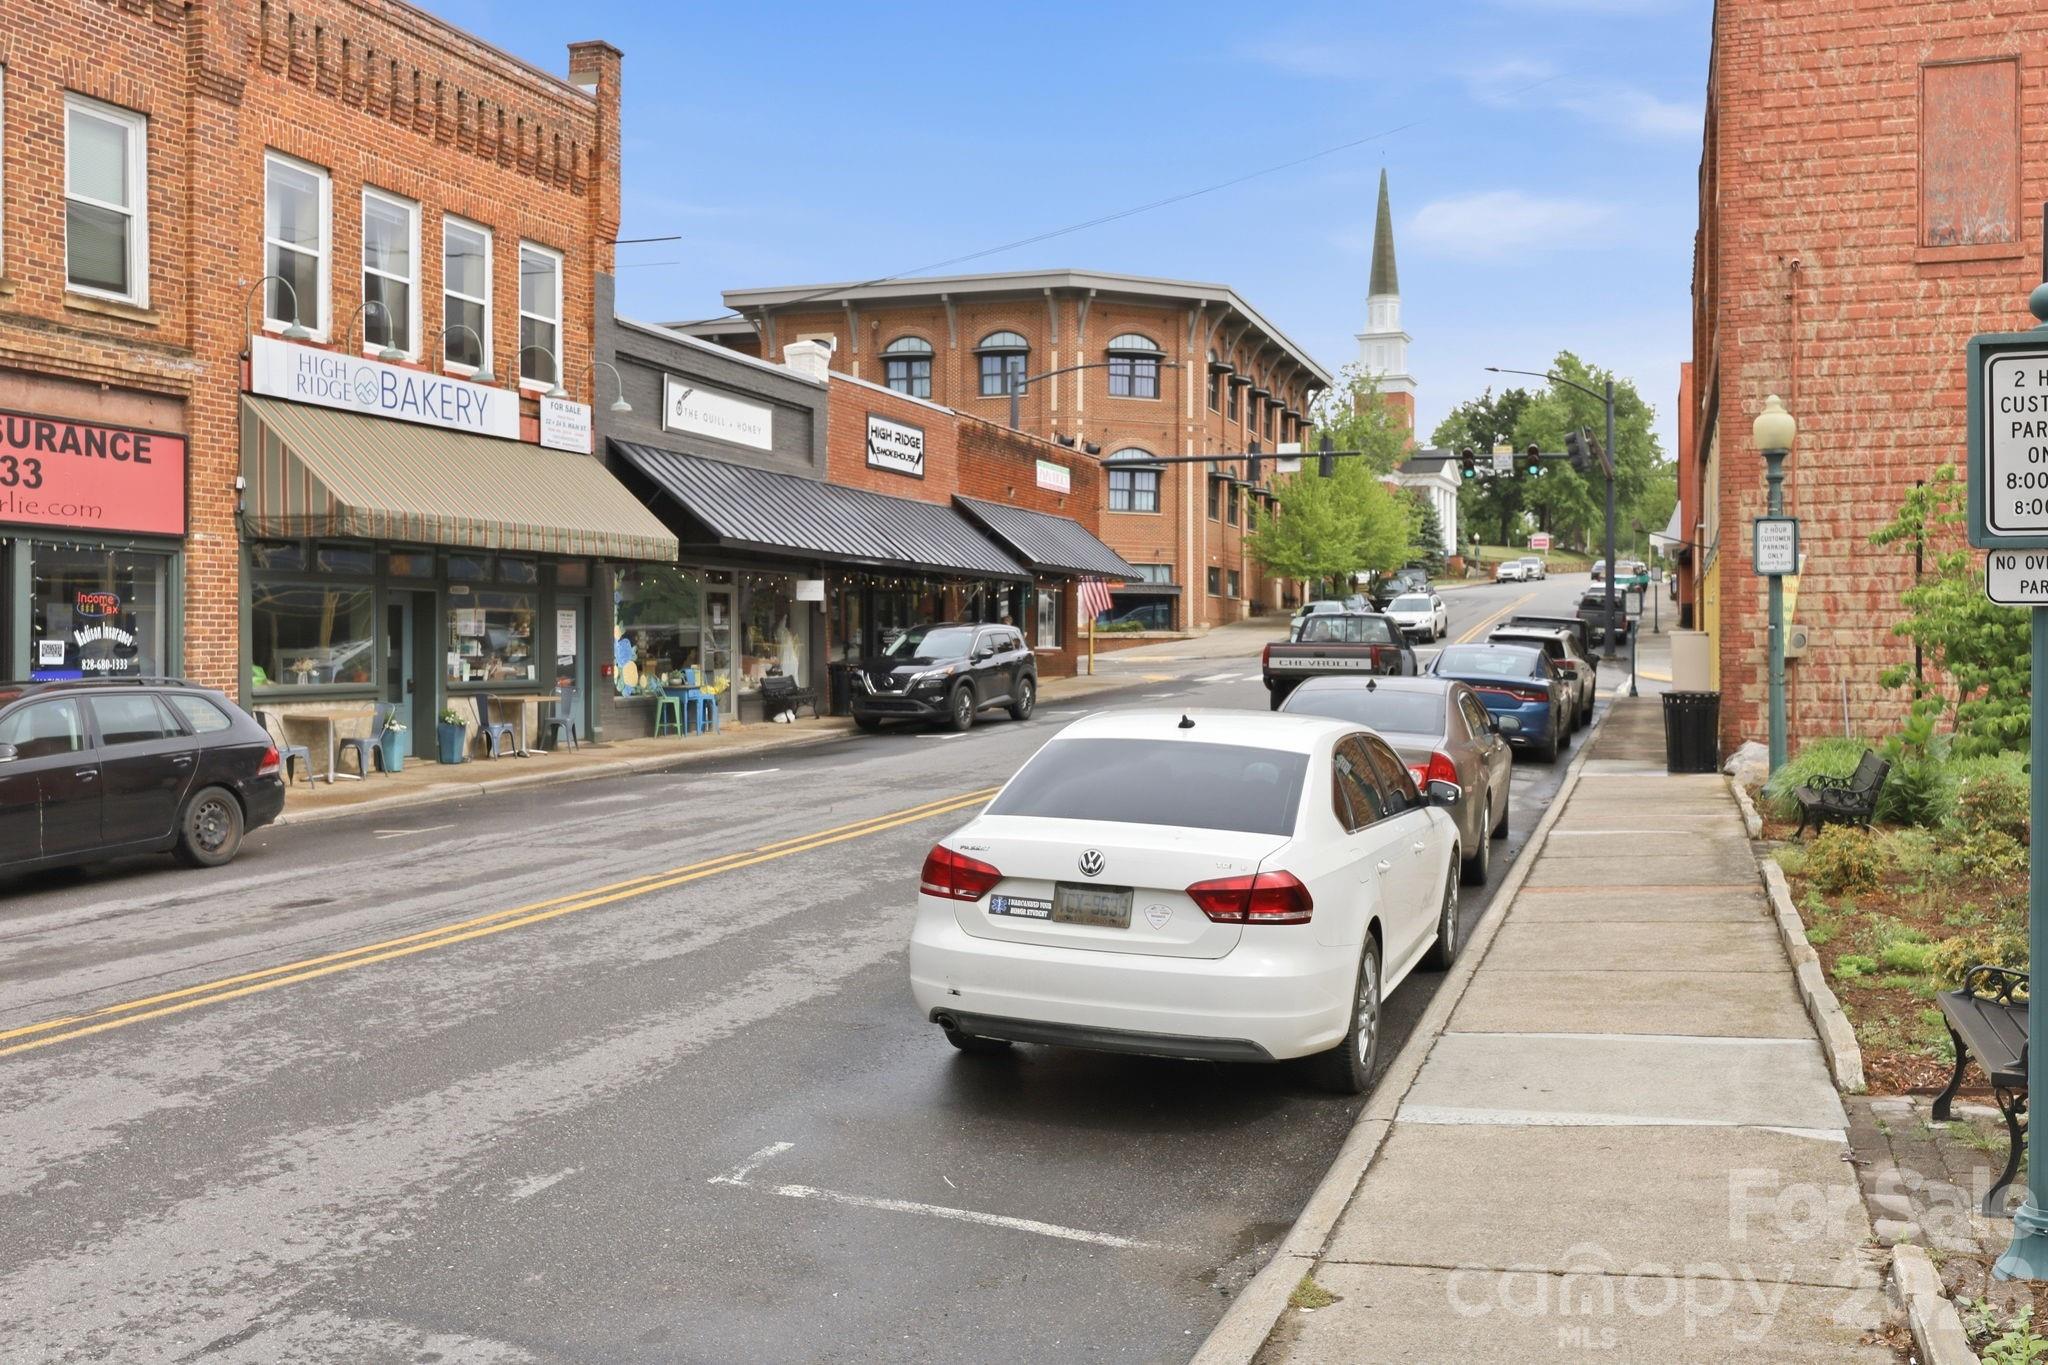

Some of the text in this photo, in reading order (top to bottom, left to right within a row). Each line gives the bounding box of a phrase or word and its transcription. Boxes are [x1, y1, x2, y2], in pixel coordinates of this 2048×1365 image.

[299, 353, 347, 380] HIGH
[2014, 370, 2025, 387] 2
[297, 373, 352, 402] RIDGE
[380, 370, 488, 427] BAKERY
[550, 401, 564, 412] FOR
[2001, 395, 2048, 413] CUST
[870, 425, 921, 449] HIGH RIDGE
[2012, 421, 2048, 438] PAR
[0, 415, 152, 464] URANCE
[2015, 498, 2048, 515] 8:0
[1767, 552, 1783, 560] ONLY
[1996, 555, 2048, 570] NO OV
[2020, 580, 2048, 594] PAR
[77, 591, 114, 605] Income
[102, 603, 119, 615] Tax
[81, 659, 128, 670] 828-680-1333
